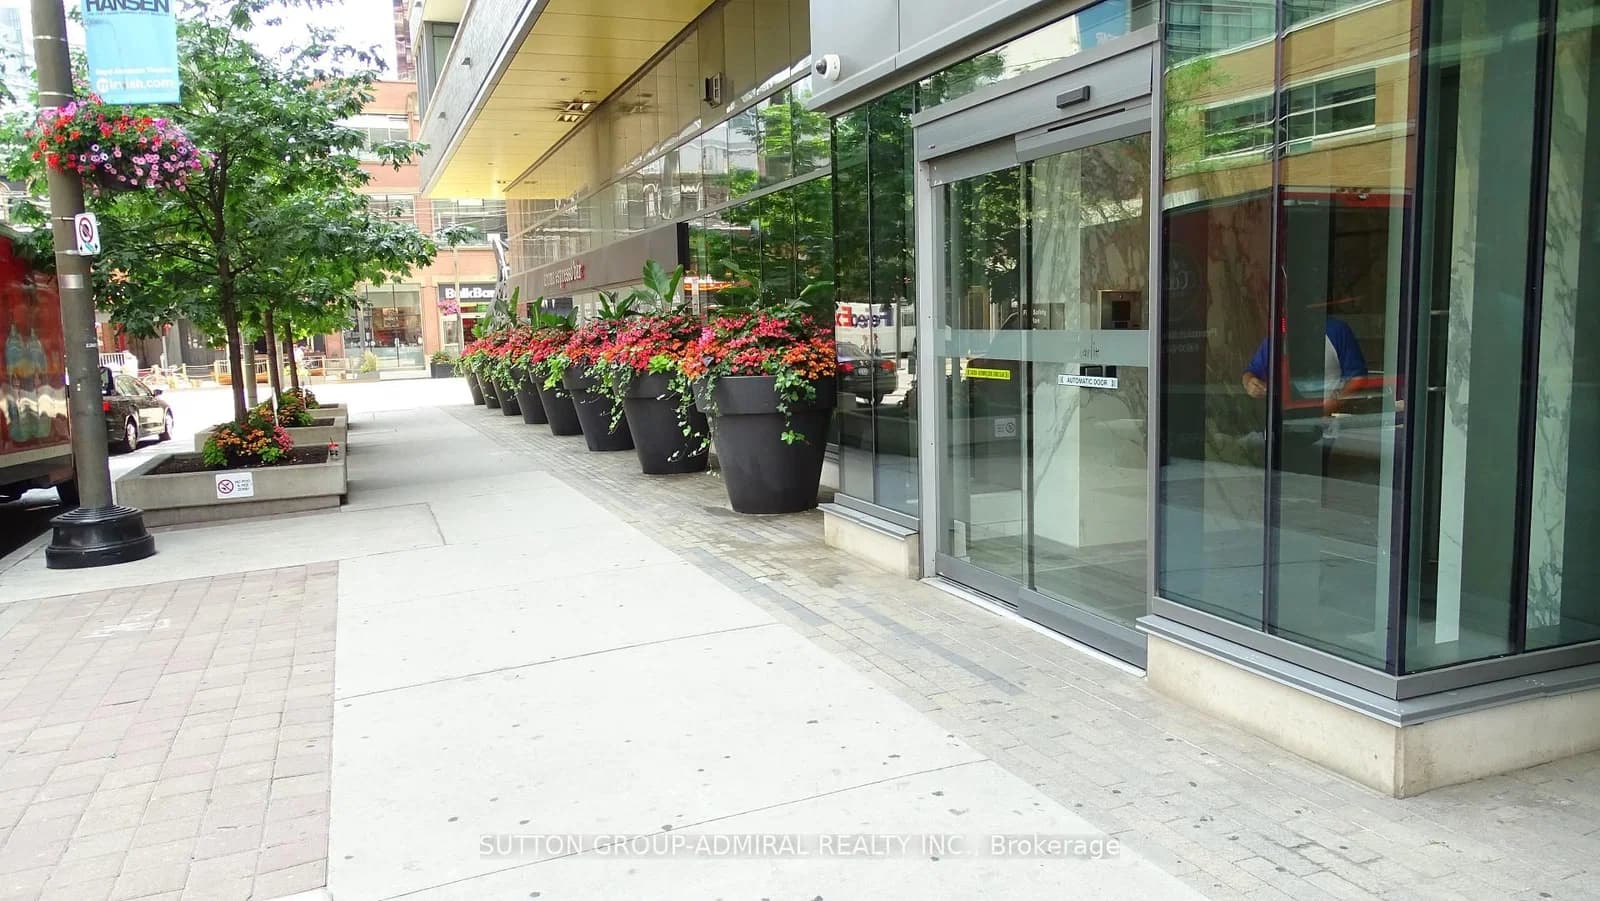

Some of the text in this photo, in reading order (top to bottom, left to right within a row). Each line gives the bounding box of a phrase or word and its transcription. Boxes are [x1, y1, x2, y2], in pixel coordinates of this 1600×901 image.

[86, 0, 170, 12] HANSEN
[445, 287, 496, 299] BlkBar
[1067, 377, 1094, 385] AUTOMATIC
